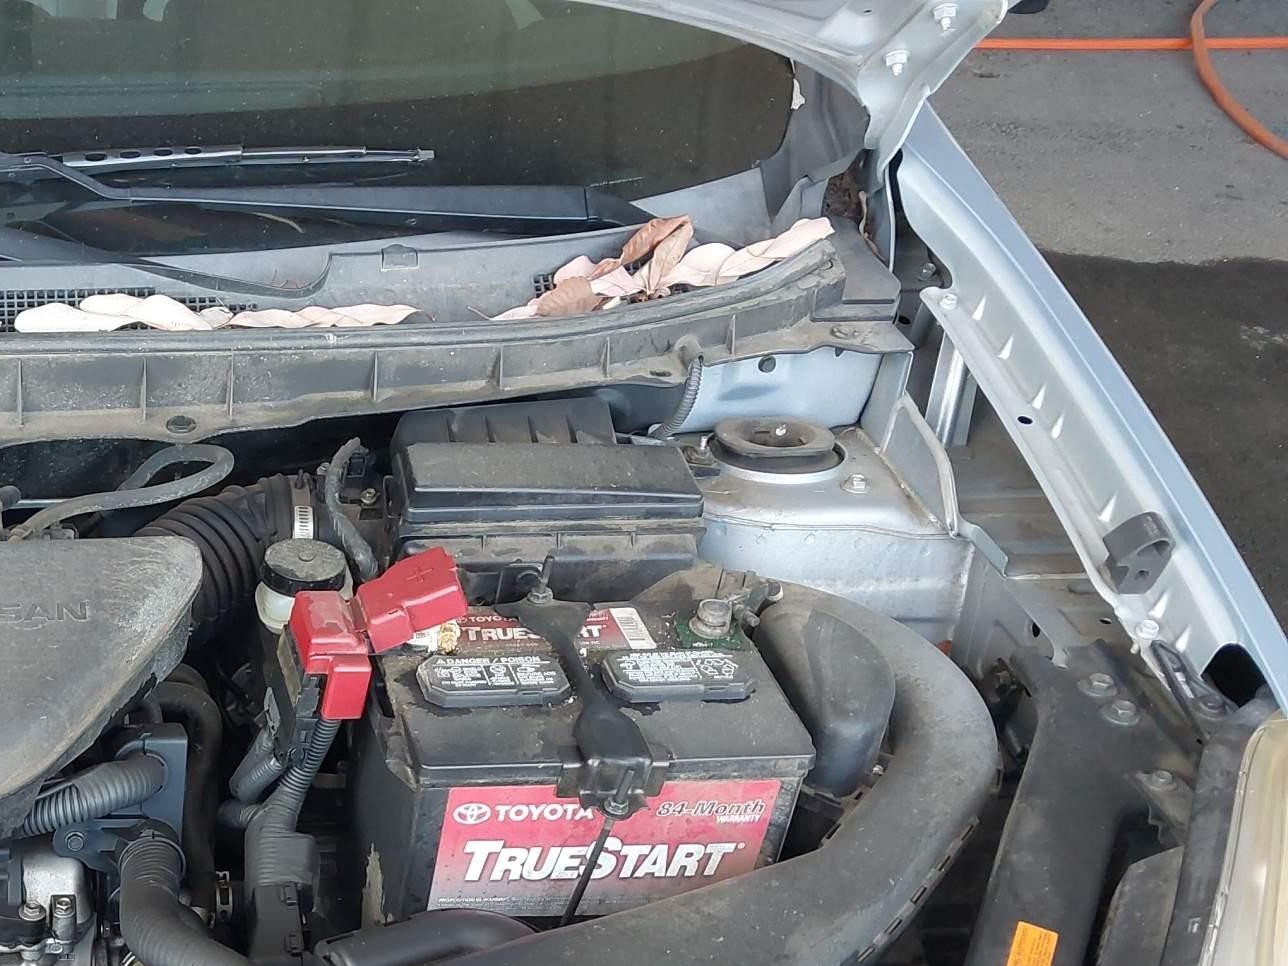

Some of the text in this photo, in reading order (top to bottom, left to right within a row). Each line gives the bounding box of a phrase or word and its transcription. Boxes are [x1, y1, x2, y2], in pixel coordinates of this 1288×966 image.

[446, 657, 489, 665] DANGER
[501, 656, 540, 664] POISON
[495, 799, 766, 822] TOYOTA 84-Month
[716, 814, 761, 824] WARRANTY
